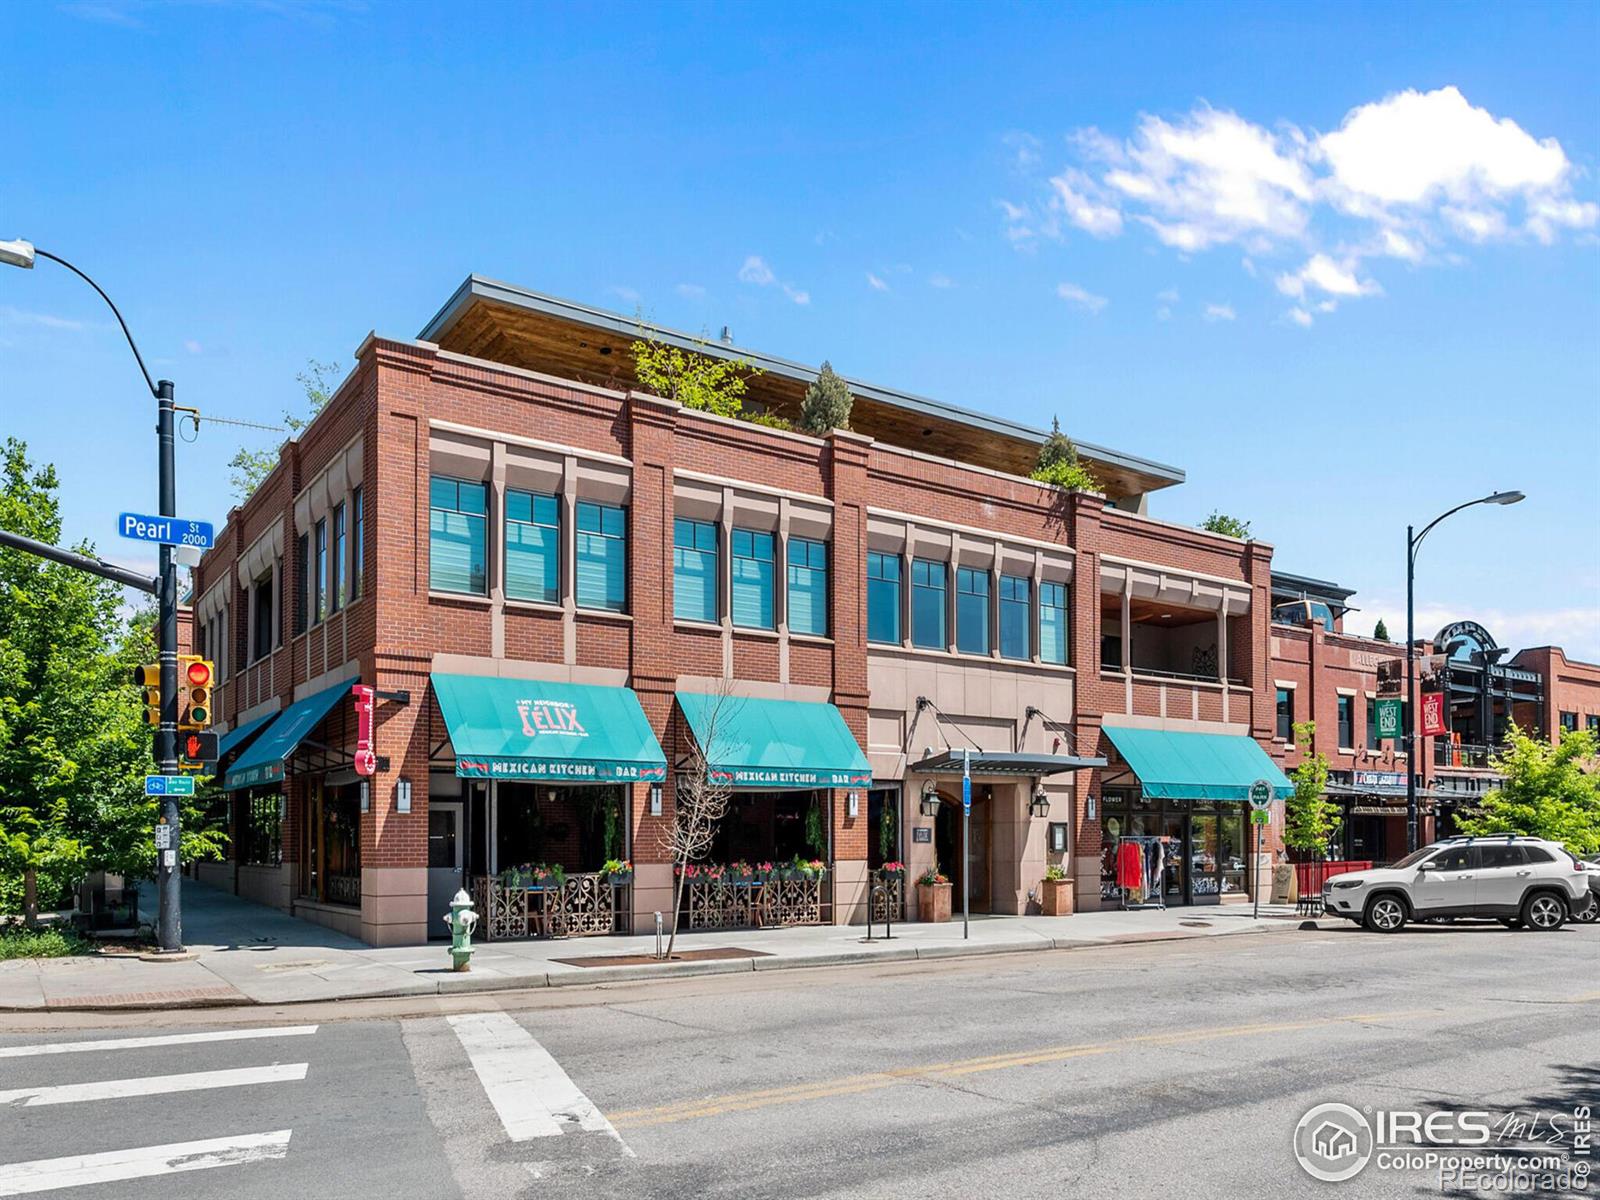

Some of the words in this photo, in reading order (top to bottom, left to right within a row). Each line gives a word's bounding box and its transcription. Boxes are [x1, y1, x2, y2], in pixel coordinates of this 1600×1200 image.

[125, 516, 170, 540] Pearl
[189, 522, 199, 533] St
[182, 533, 206, 545] 2000
[1379, 706, 1397, 717] WEST
[1423, 702, 1439, 714] WEST
[1380, 717, 1396, 728] END
[1424, 713, 1439, 726] END
[492, 762, 546, 774] MEXICAN
[549, 763, 596, 776] KITCHEN
[615, 766, 638, 777] BAR
[735, 771, 778, 782] MEXICAN
[779, 772, 817, 783] KITCHEN
[832, 774, 849, 784] BAR
[1102, 796, 1122, 804] FLOWER
